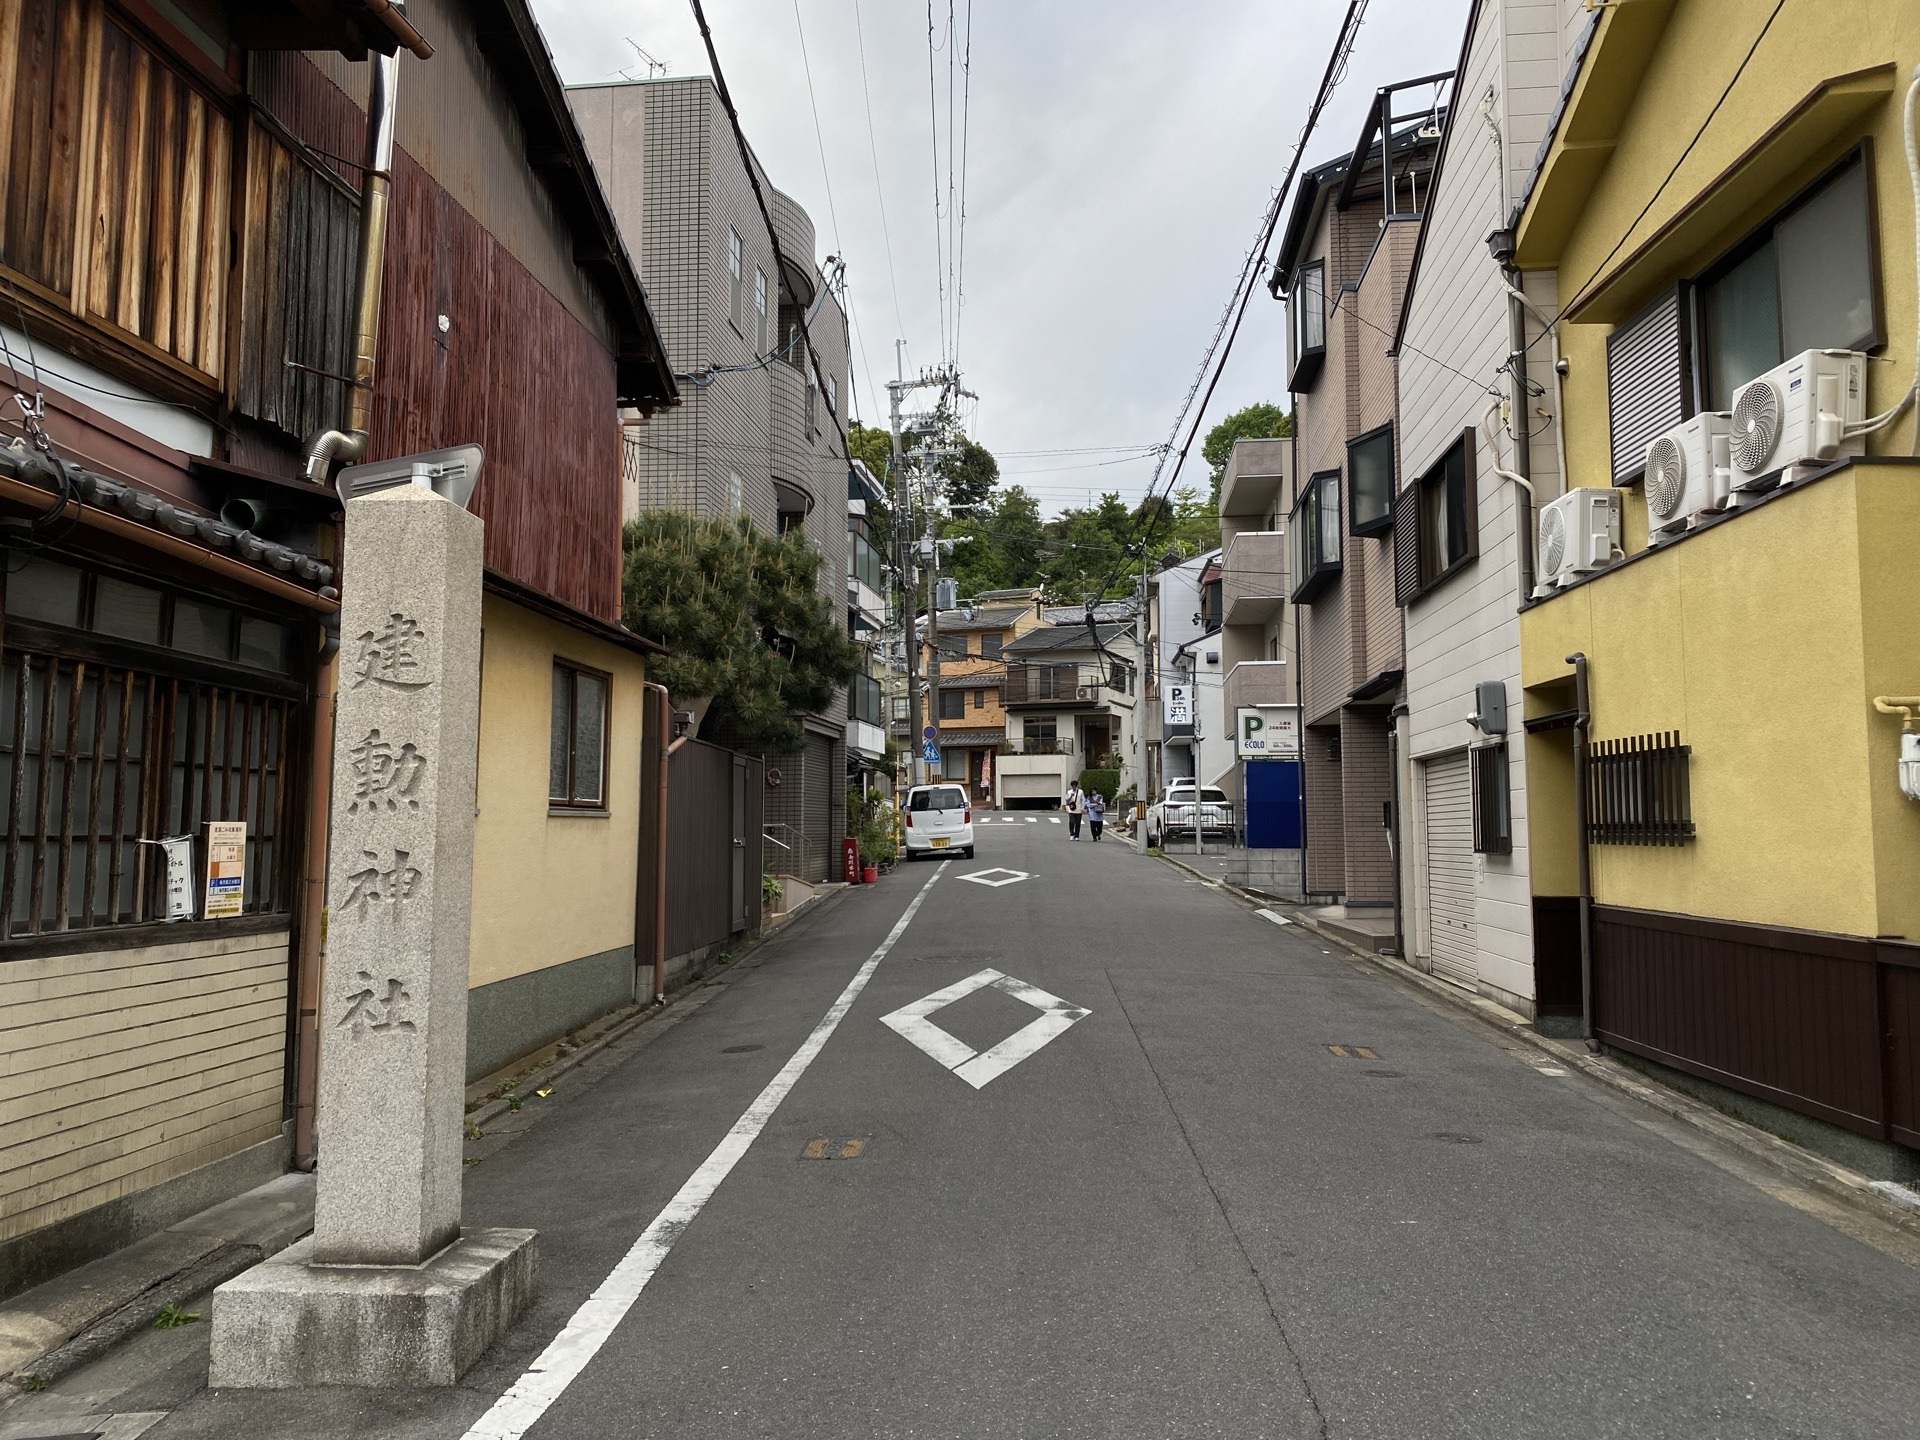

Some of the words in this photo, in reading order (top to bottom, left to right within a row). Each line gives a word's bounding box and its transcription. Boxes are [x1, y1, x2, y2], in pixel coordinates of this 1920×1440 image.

[1171, 687, 1183, 701] P
[1243, 715, 1264, 740] P
[1244, 740, 1265, 749] ECOLO
[334, 612, 434, 1036] 建勲神社
